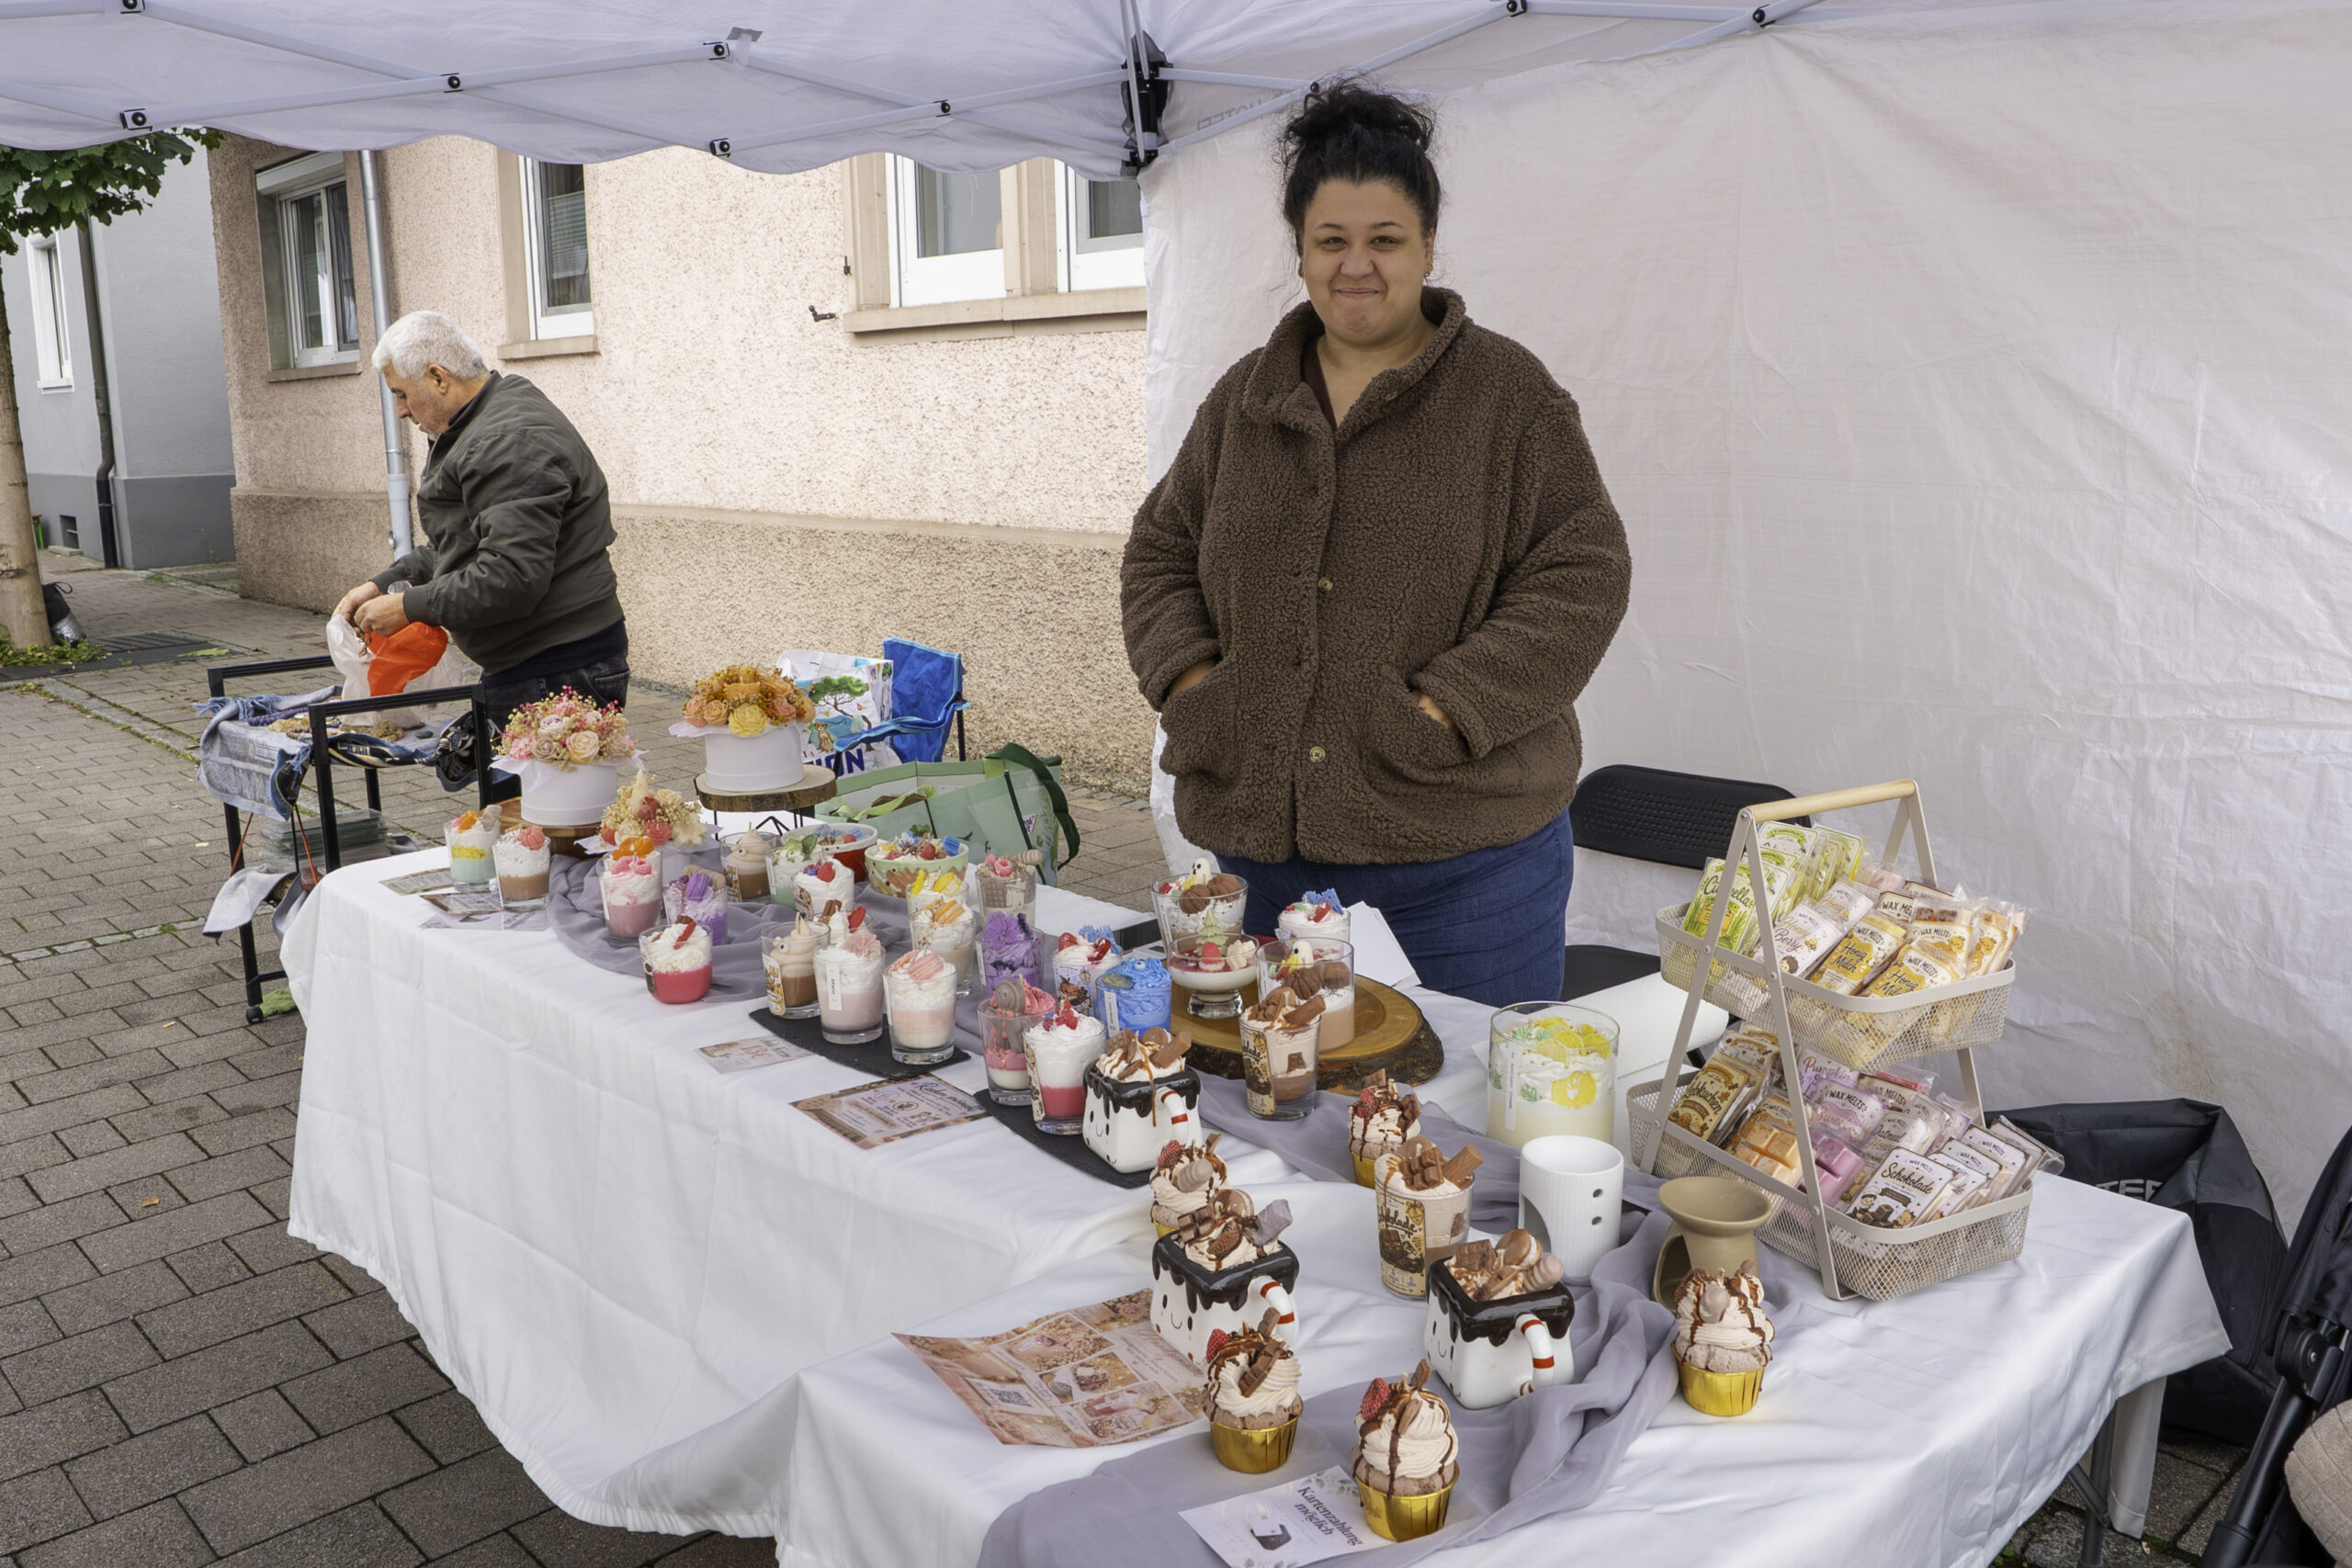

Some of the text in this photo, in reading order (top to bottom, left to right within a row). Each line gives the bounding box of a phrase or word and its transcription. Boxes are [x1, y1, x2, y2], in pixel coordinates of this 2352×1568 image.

[1882, 901, 1899, 910] WAX
[1774, 928, 1803, 953] Berry
[1857, 926, 1883, 943] WAX MELTS
[1920, 928, 1950, 938] WAX MELTS
[1840, 942, 1868, 963] Honig
[1830, 955, 1858, 974] Milch
[1907, 956, 1938, 977] WAX MELTS
[1886, 969, 1919, 993] Honig
[1685, 1080, 1723, 1115] Lebkuchen
[1829, 1091, 1865, 1111] WAX MELTS
[1885, 1089, 1905, 1106] MELTS
[1882, 1162, 1933, 1195] Schokolade
[1295, 1504, 1335, 1535] möglich
[1297, 1486, 1363, 1546] Kartenzahlung
